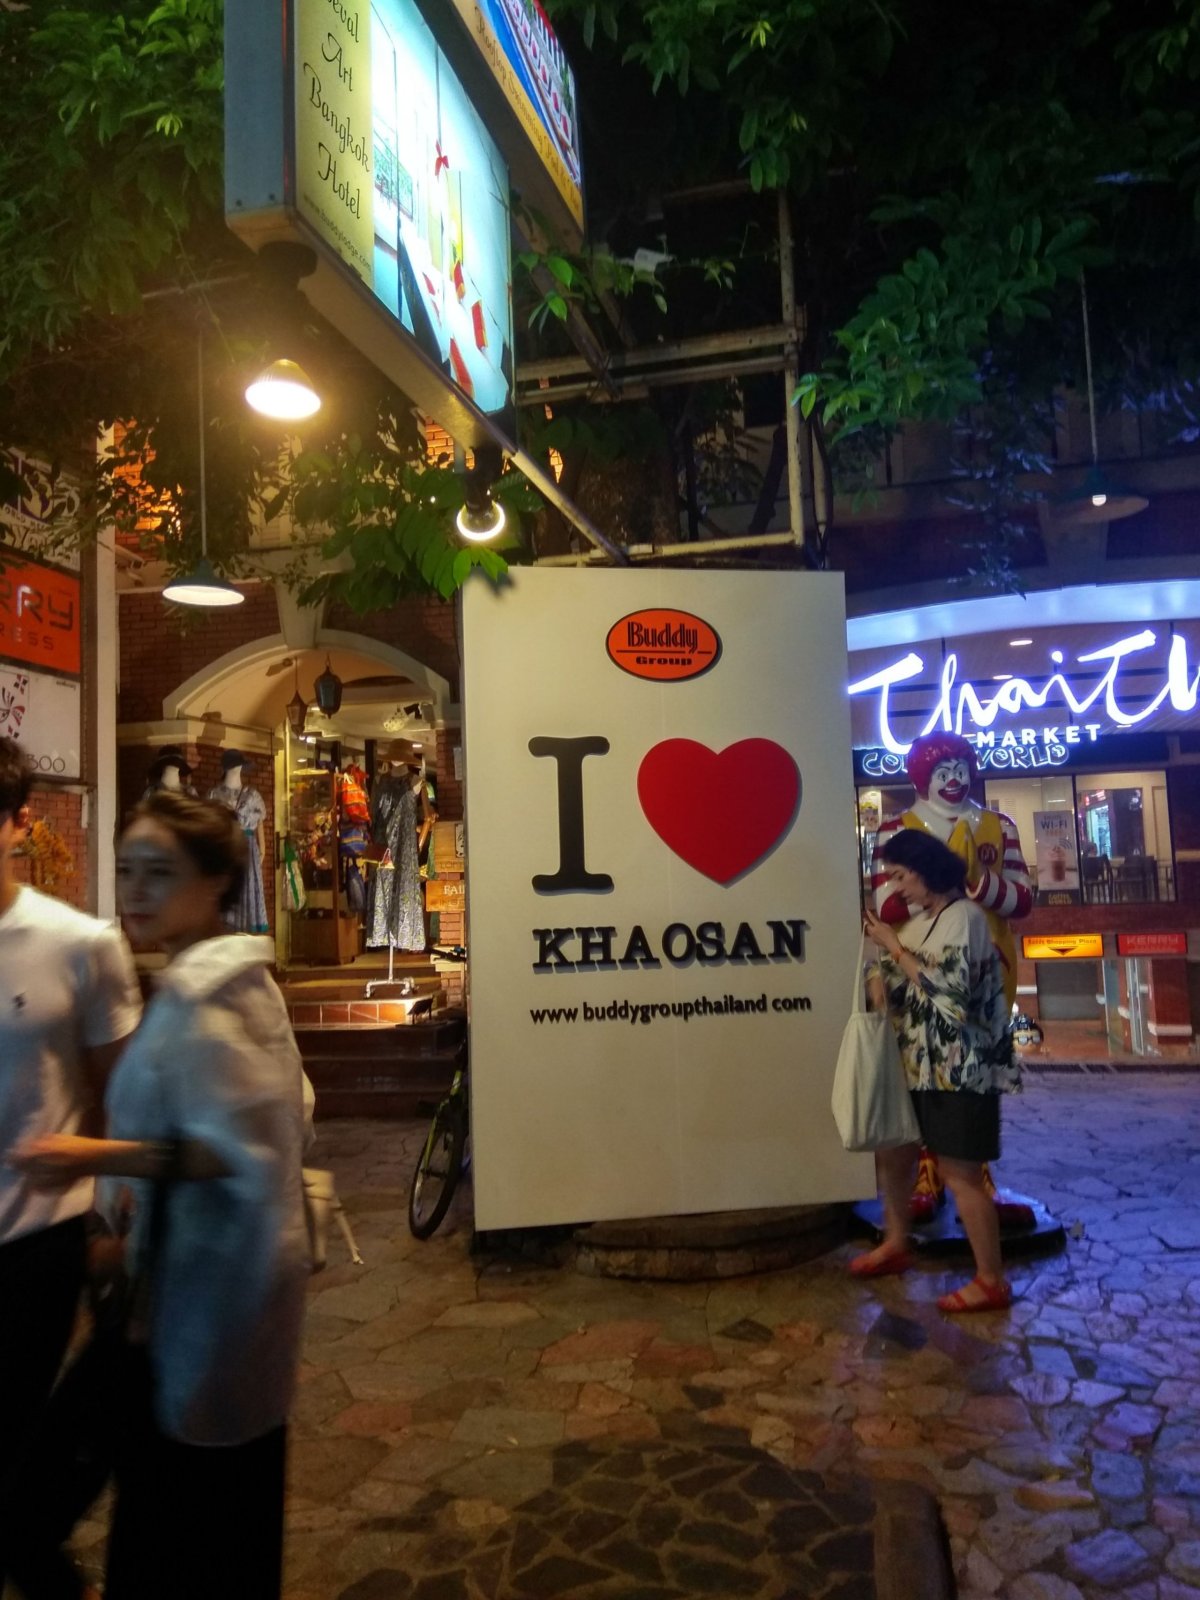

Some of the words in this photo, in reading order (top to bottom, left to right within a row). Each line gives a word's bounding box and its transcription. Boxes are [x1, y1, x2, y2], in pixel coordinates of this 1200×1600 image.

[328, 0, 359, 43] eval
[321, 32, 353, 92] Art
[303, 62, 370, 173] Bangkok
[317, 142, 361, 219] Hotel
[627, 621, 698, 654] Buddy
[635, 656, 692, 666] Group
[976, 724, 1101, 747] MARKET
[528, 736, 614, 893] I
[532, 919, 808, 970] KHAOSAN
[530, 1007, 578, 1025] www
[583, 994, 767, 1023] buddygroupthailand
[772, 997, 812, 1012] com
